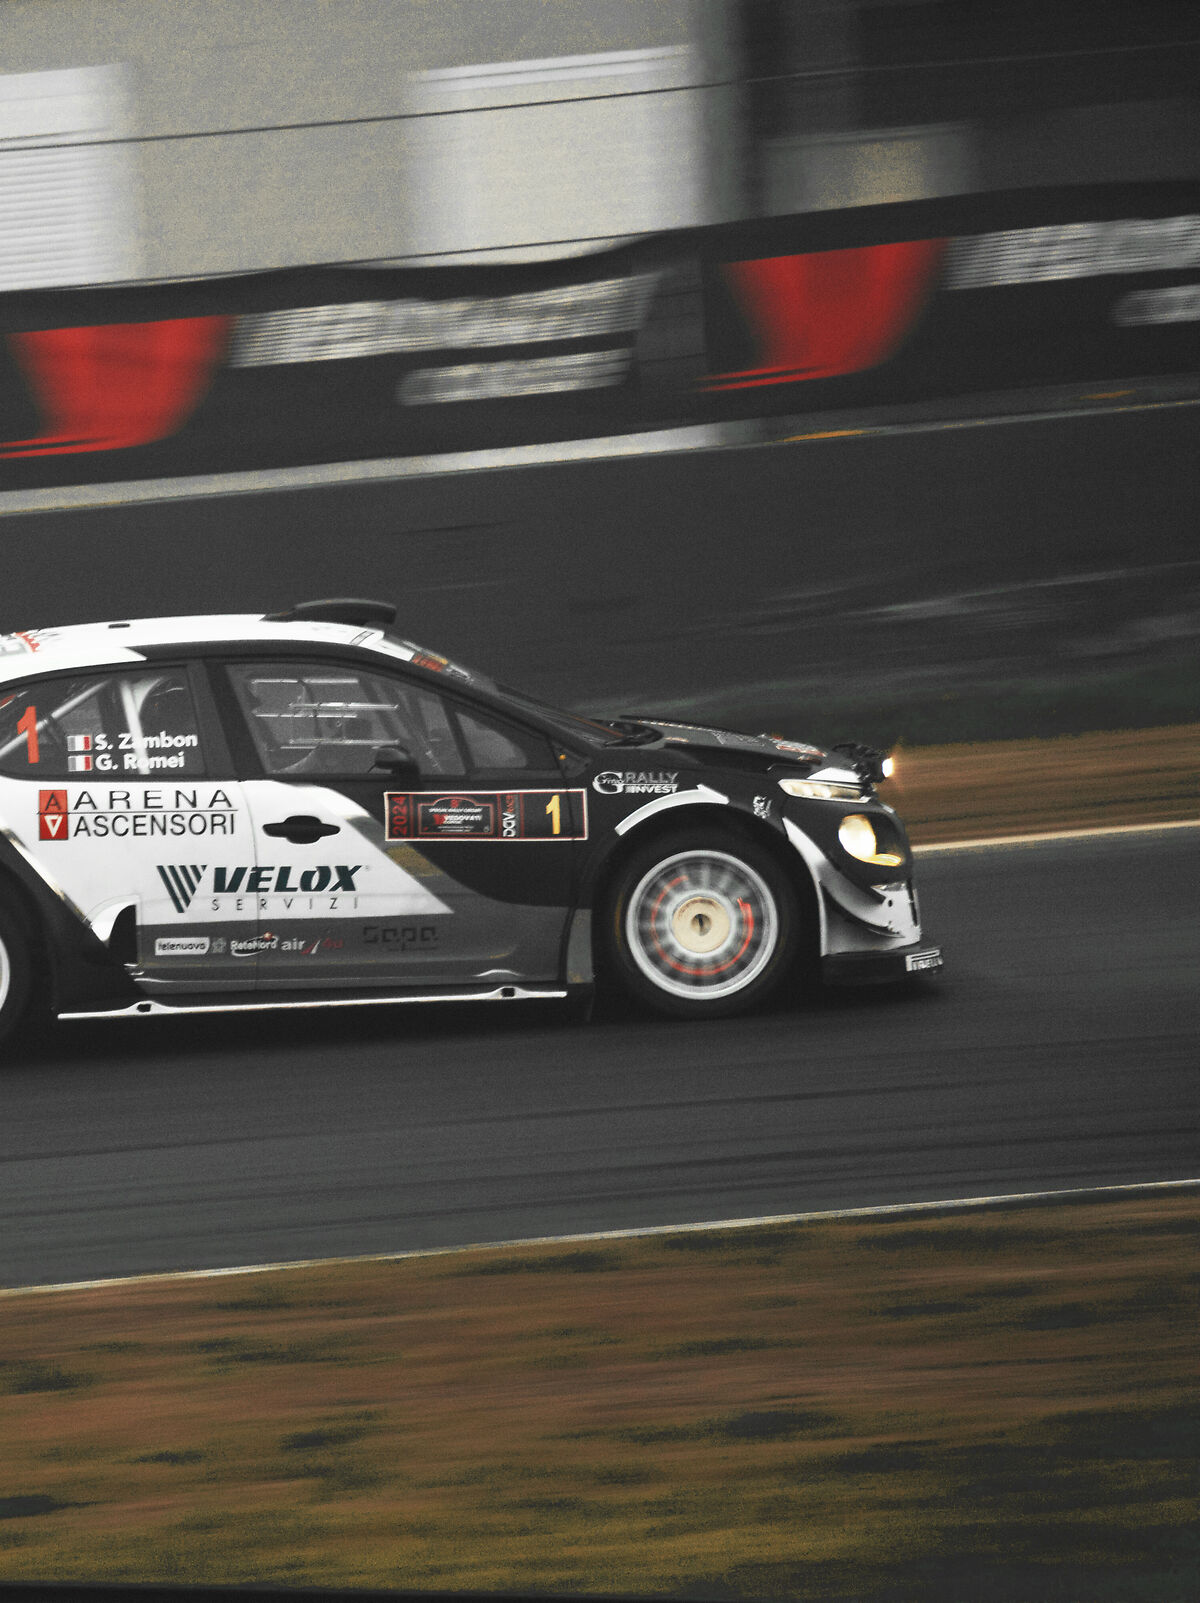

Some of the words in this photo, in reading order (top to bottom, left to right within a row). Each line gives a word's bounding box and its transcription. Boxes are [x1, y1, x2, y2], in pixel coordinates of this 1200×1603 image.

[17, 705, 39, 764] 1
[94, 733, 113, 750] S.
[95, 753, 118, 771] G.
[123, 751, 184, 771] Romei
[625, 771, 679, 784] RALLY
[73, 790, 232, 811] ARENA
[392, 797, 408, 836] 2024
[546, 795, 561, 834] 1
[73, 813, 234, 838] ASCENSORI
[213, 865, 362, 893] VELOX
[211, 898, 358, 911] SERVIZI
[281, 938, 306, 951] air
